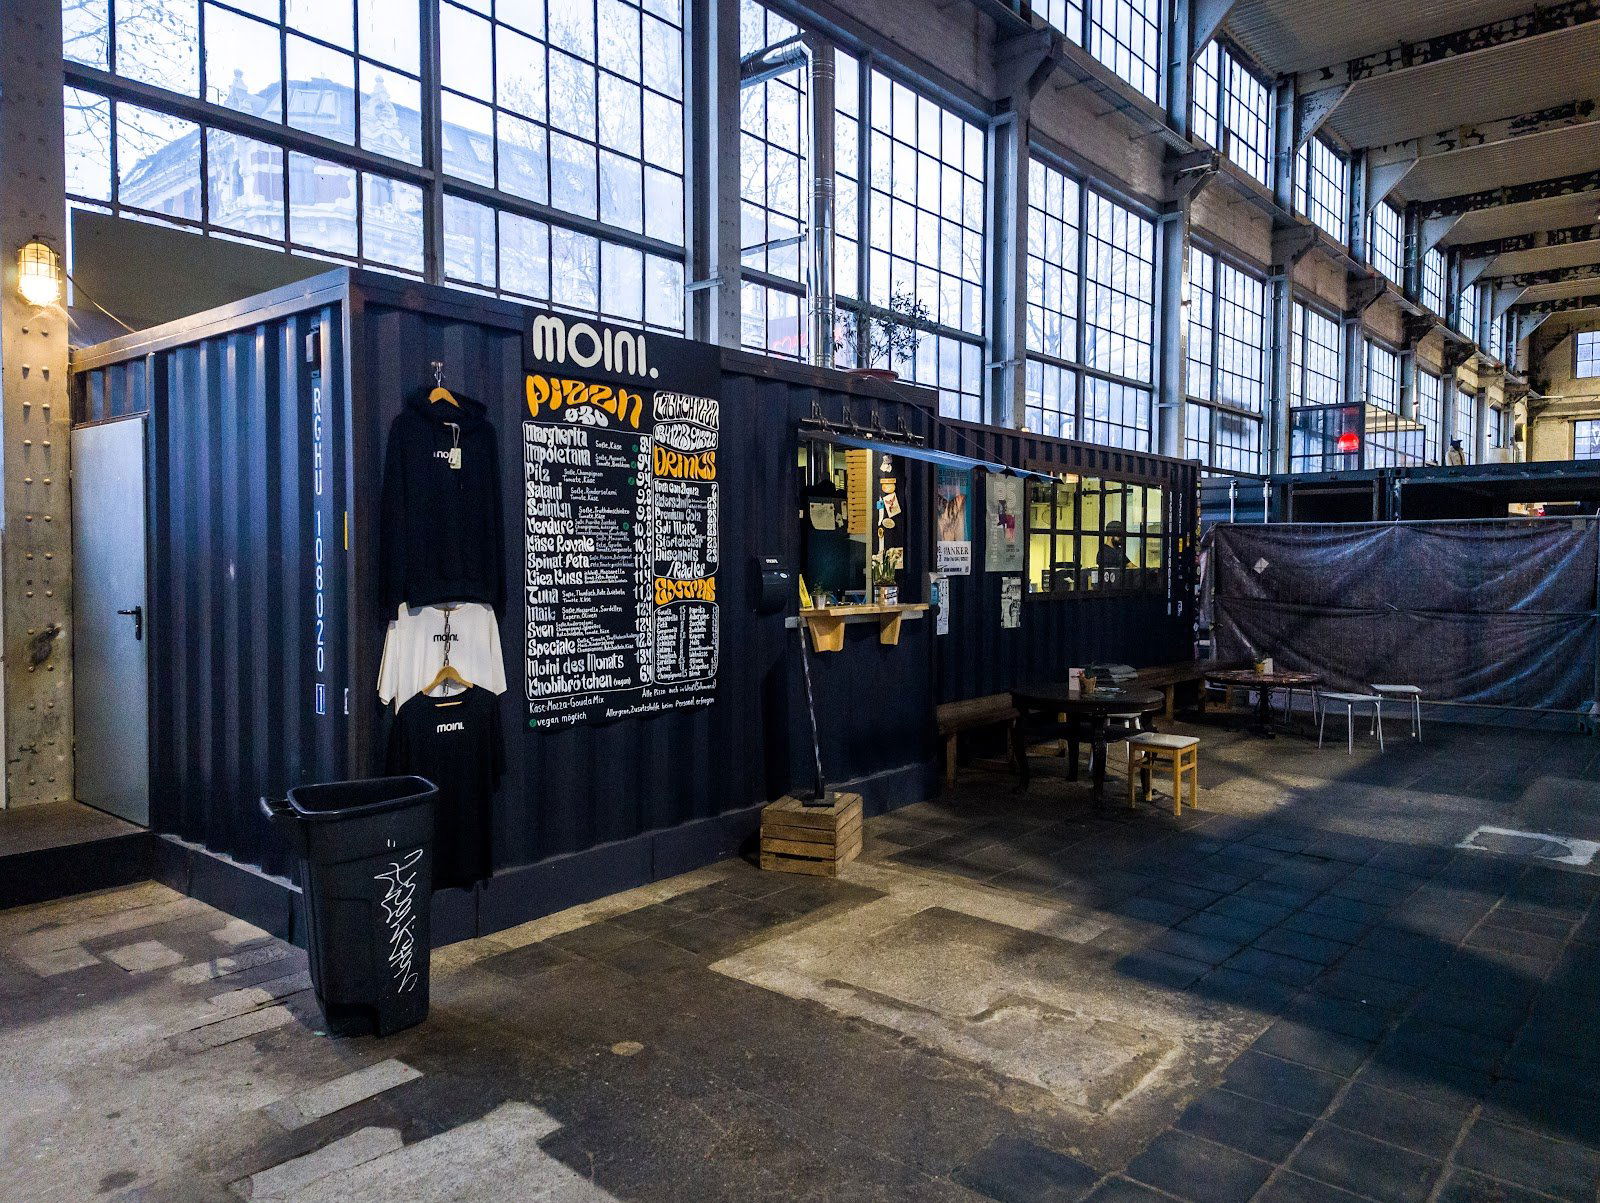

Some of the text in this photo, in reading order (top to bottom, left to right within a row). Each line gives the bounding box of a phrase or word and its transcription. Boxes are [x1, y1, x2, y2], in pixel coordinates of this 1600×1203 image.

[313, 387, 322, 496] RGHU
[527, 481, 562, 500] Salami
[527, 517, 574, 535] Verdure
[315, 510, 325, 673] 108020
[526, 586, 559, 604] Tuna
[528, 622, 554, 638] Sven
[528, 638, 576, 658] Speciale
[527, 653, 624, 677] Moini des Monats
[528, 672, 612, 697] Knobibrötchen
[537, 712, 587, 727] vegan möglich
